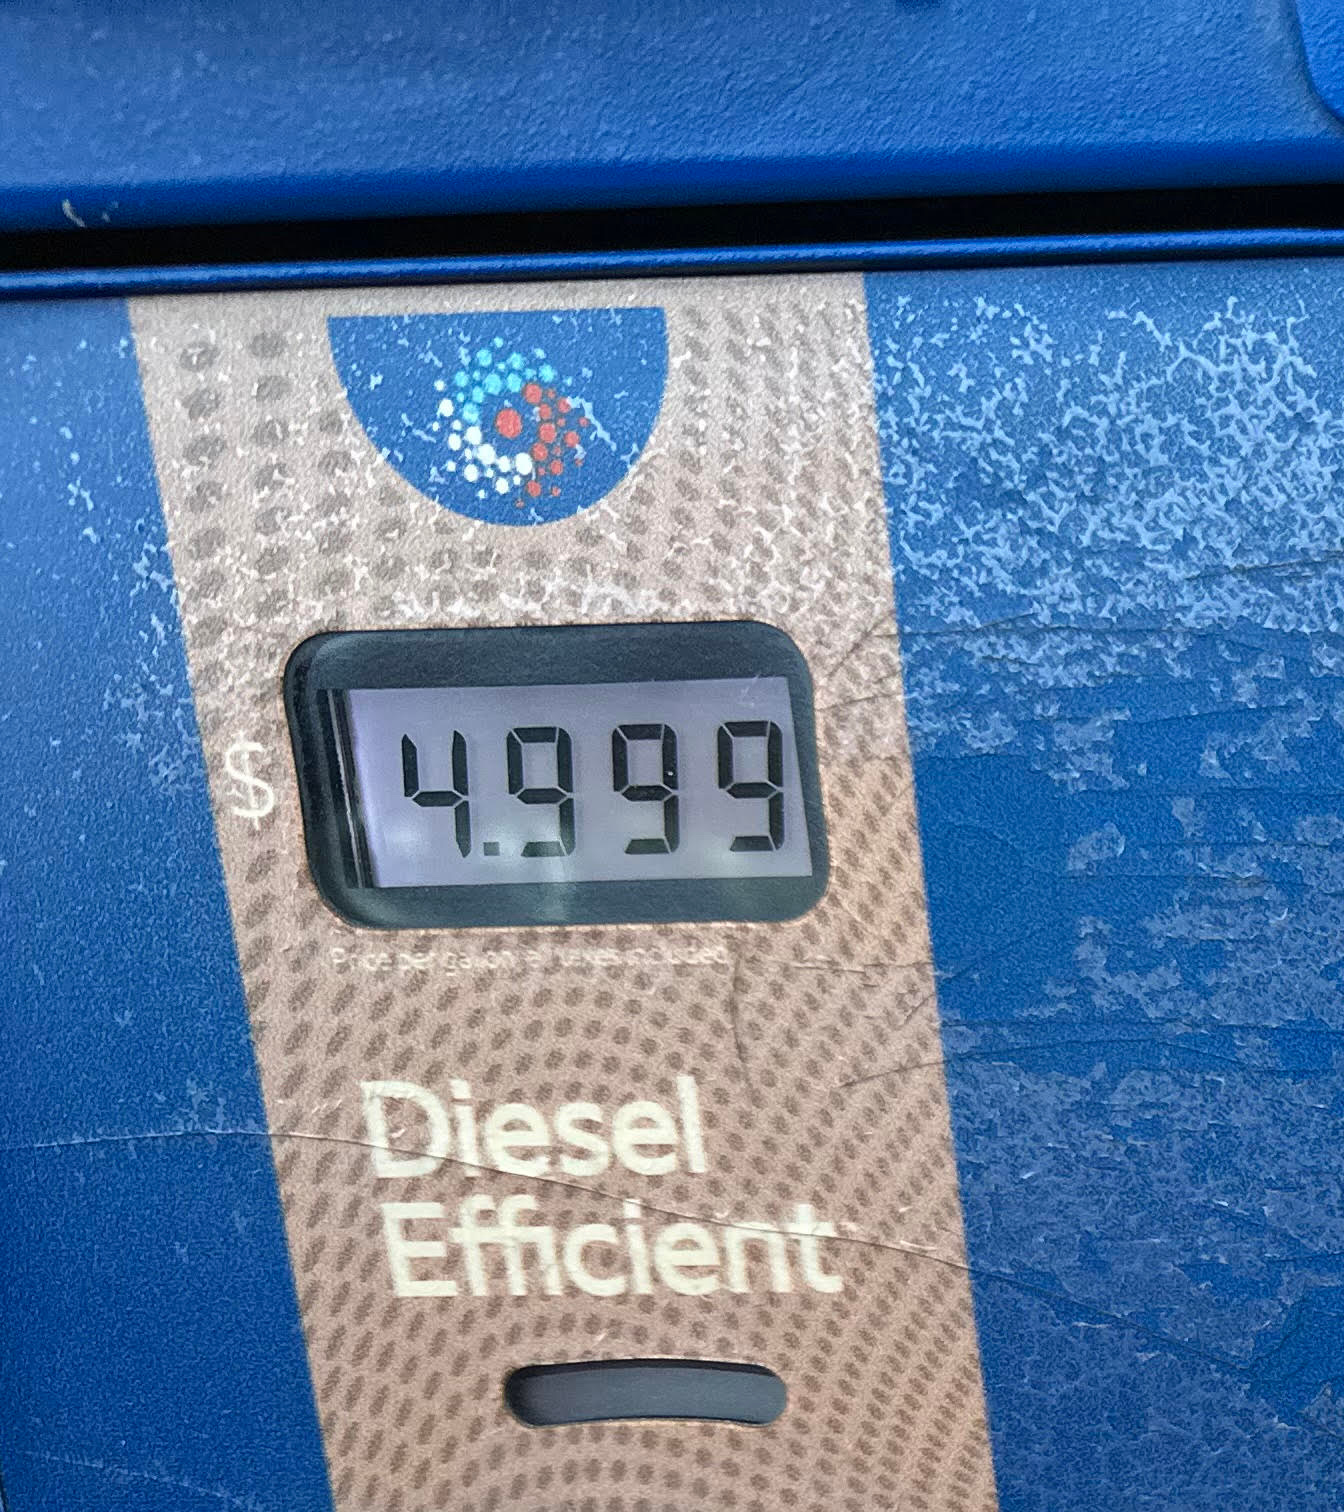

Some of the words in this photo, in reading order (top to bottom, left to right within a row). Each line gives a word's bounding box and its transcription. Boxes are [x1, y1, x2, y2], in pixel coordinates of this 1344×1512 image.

[222, 731, 274, 828] $
[401, 720, 786, 858] 4.999
[361, 1075, 707, 1180] Diesel
[380, 1194, 844, 1298] Efficient
